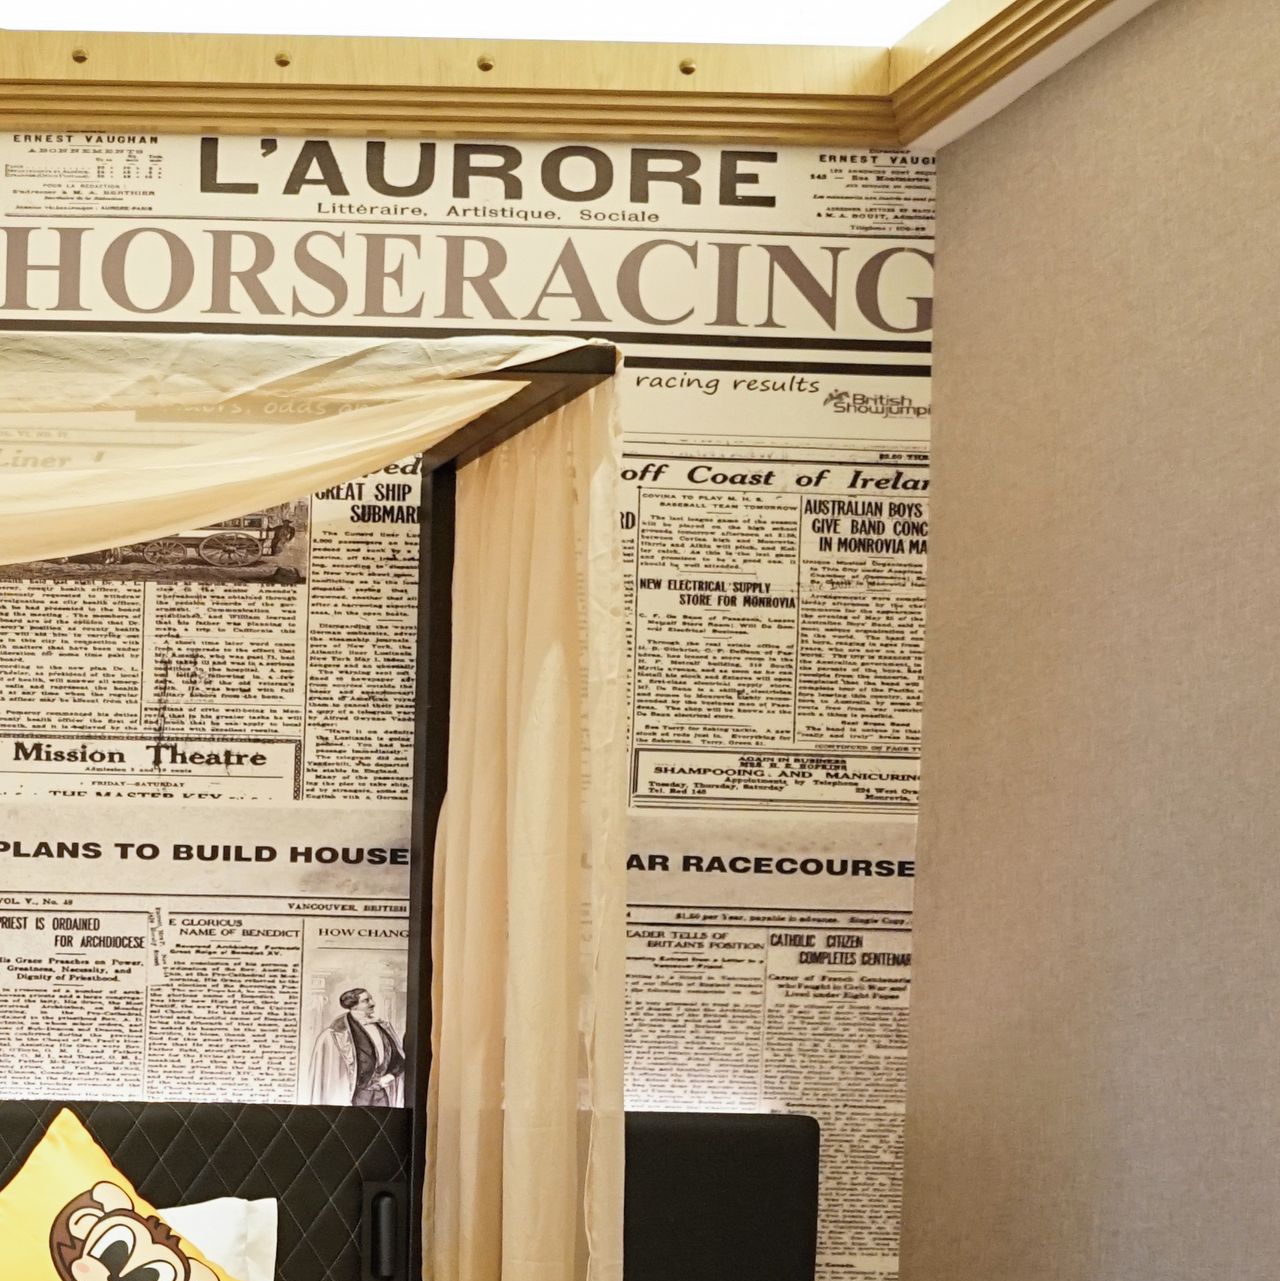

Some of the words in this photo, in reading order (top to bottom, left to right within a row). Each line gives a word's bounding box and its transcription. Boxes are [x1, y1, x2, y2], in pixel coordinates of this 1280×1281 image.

[580, 210, 659, 222] Sociale
[636, 372, 719, 395] racing
[734, 376, 819, 393] results
[853, 393, 912, 406] British
[621, 464, 669, 482] off
[688, 466, 776, 486] Coast
[796, 469, 830, 488] of
[804, 499, 883, 518] AUSTRALIAN
[889, 501, 925, 519] BOYS
[812, 518, 842, 535] GIVE
[851, 519, 884, 536] BAND
[819, 538, 832, 551] IN
[836, 537, 904, 554] MONROVIA
[640, 579, 662, 589] NEW
[668, 580, 726, 592] ELECTRICAL
[733, 582, 770, 593] SUPPLY
[680, 594, 711, 606] STORE
[718, 595, 737, 606] FOR
[743, 595, 795, 608] MONROVIA
[13, 743, 125, 765] Mission
[146, 745, 267, 767] Theatre
[114, 843, 159, 860] TO
[173, 844, 277, 863] BUILD
[290, 846, 410, 866] HOUSE
[682, 855, 914, 876] RACECOURSE
[36, 917, 45, 930] IS
[52, 917, 100, 931] ORDAINED
[55, 935, 73, 947] FOR
[80, 936, 144, 948] ARCHDIOCESE
